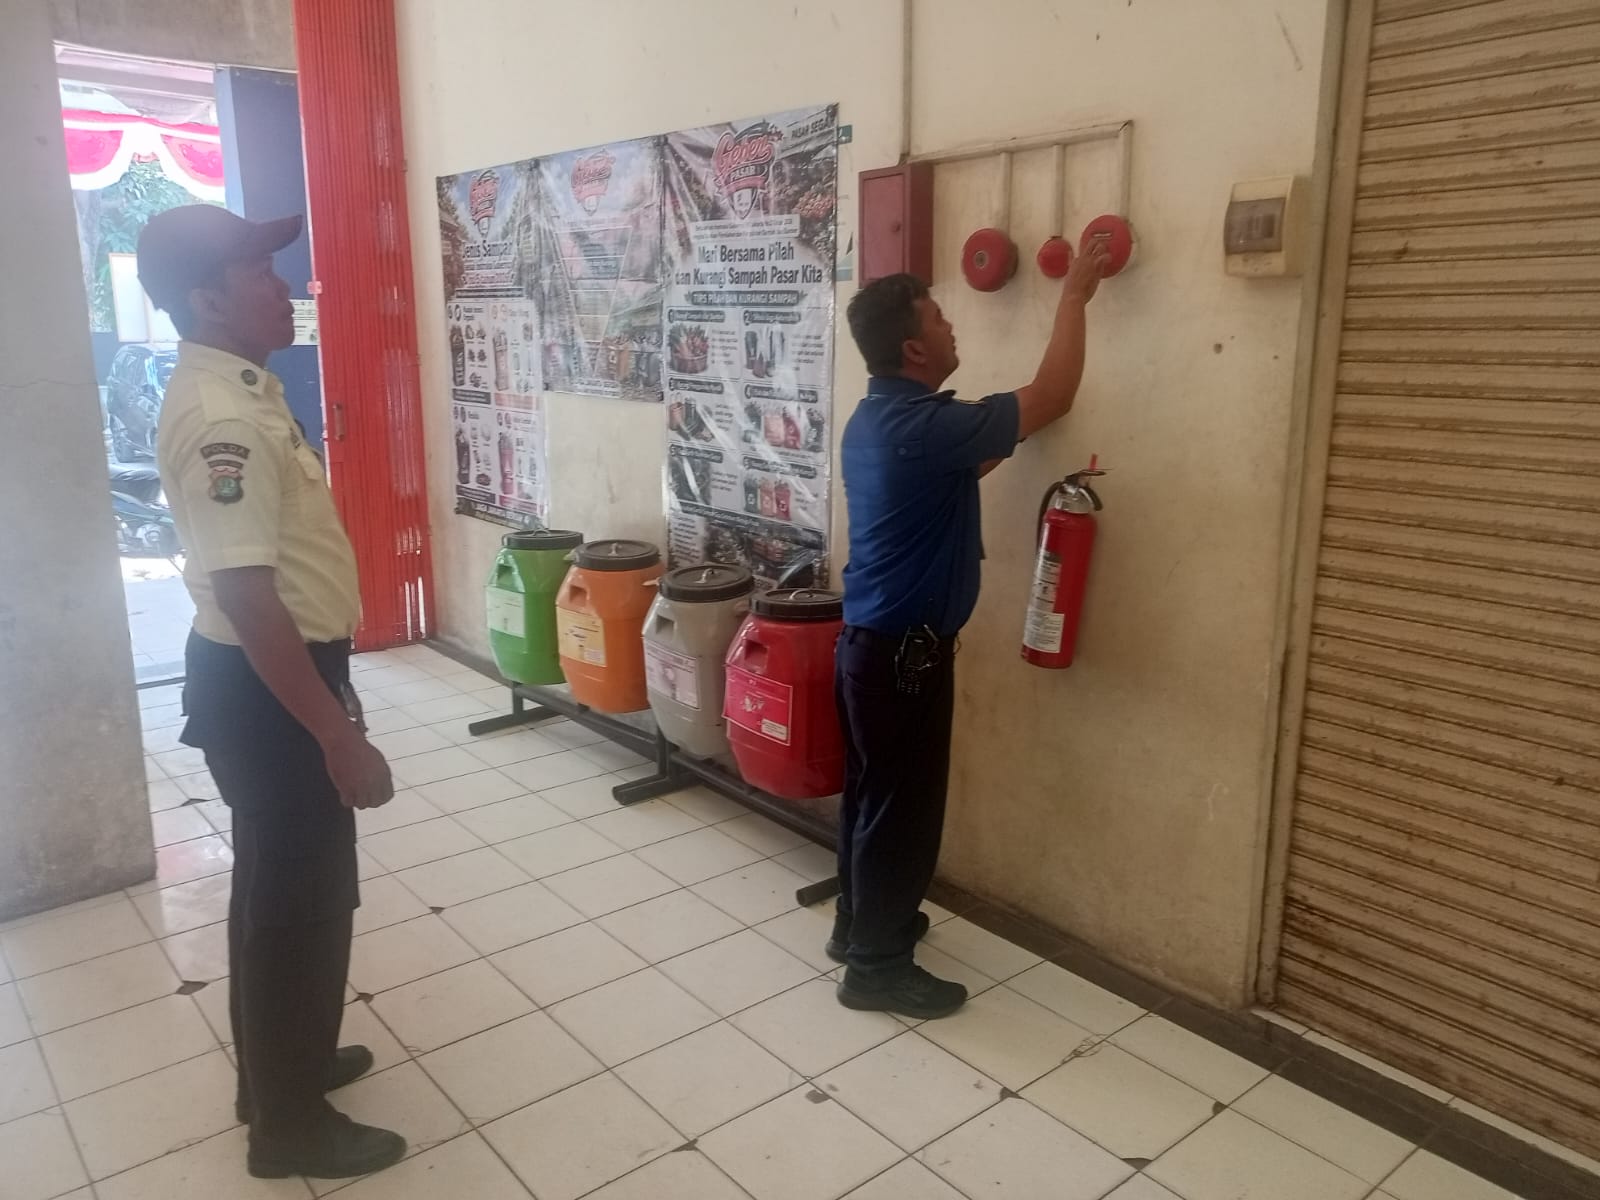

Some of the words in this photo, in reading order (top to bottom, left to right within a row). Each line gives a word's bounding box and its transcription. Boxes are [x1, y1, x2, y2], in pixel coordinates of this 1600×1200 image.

[731, 165, 757, 180] PASAR
[720, 244, 765, 263] Bersama
[768, 241, 795, 261] Pilah
[693, 267, 726, 288] Kurangi
[728, 266, 769, 288] Sampah
[770, 266, 800, 284] Pasar
[801, 264, 823, 283] Kita
[693, 294, 707, 304] TIPS
[768, 293, 798, 304] SAMPAH
[202, 445, 247, 458] POLDA
